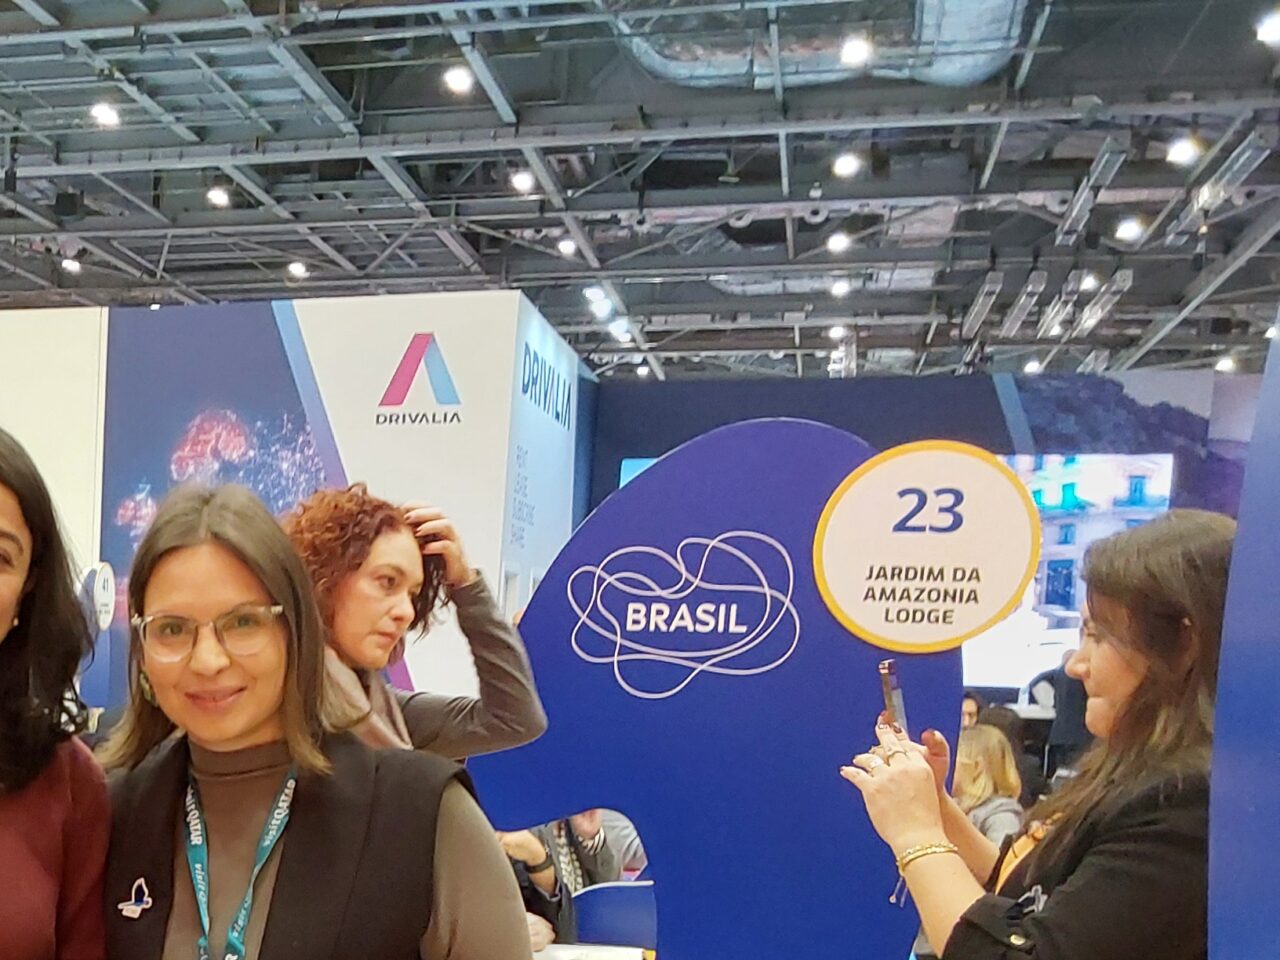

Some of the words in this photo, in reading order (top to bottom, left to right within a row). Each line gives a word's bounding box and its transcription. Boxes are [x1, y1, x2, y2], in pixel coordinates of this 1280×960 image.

[522, 340, 571, 431] DRIVALIA
[376, 412, 462, 425] DRIVALIA
[892, 488, 964, 533] 23
[865, 565, 944, 582] JARDIM
[952, 566, 981, 582] DA
[863, 586, 979, 604] AMAZONIA
[626, 603, 748, 633] BRASIL
[884, 608, 955, 624] LODGE
